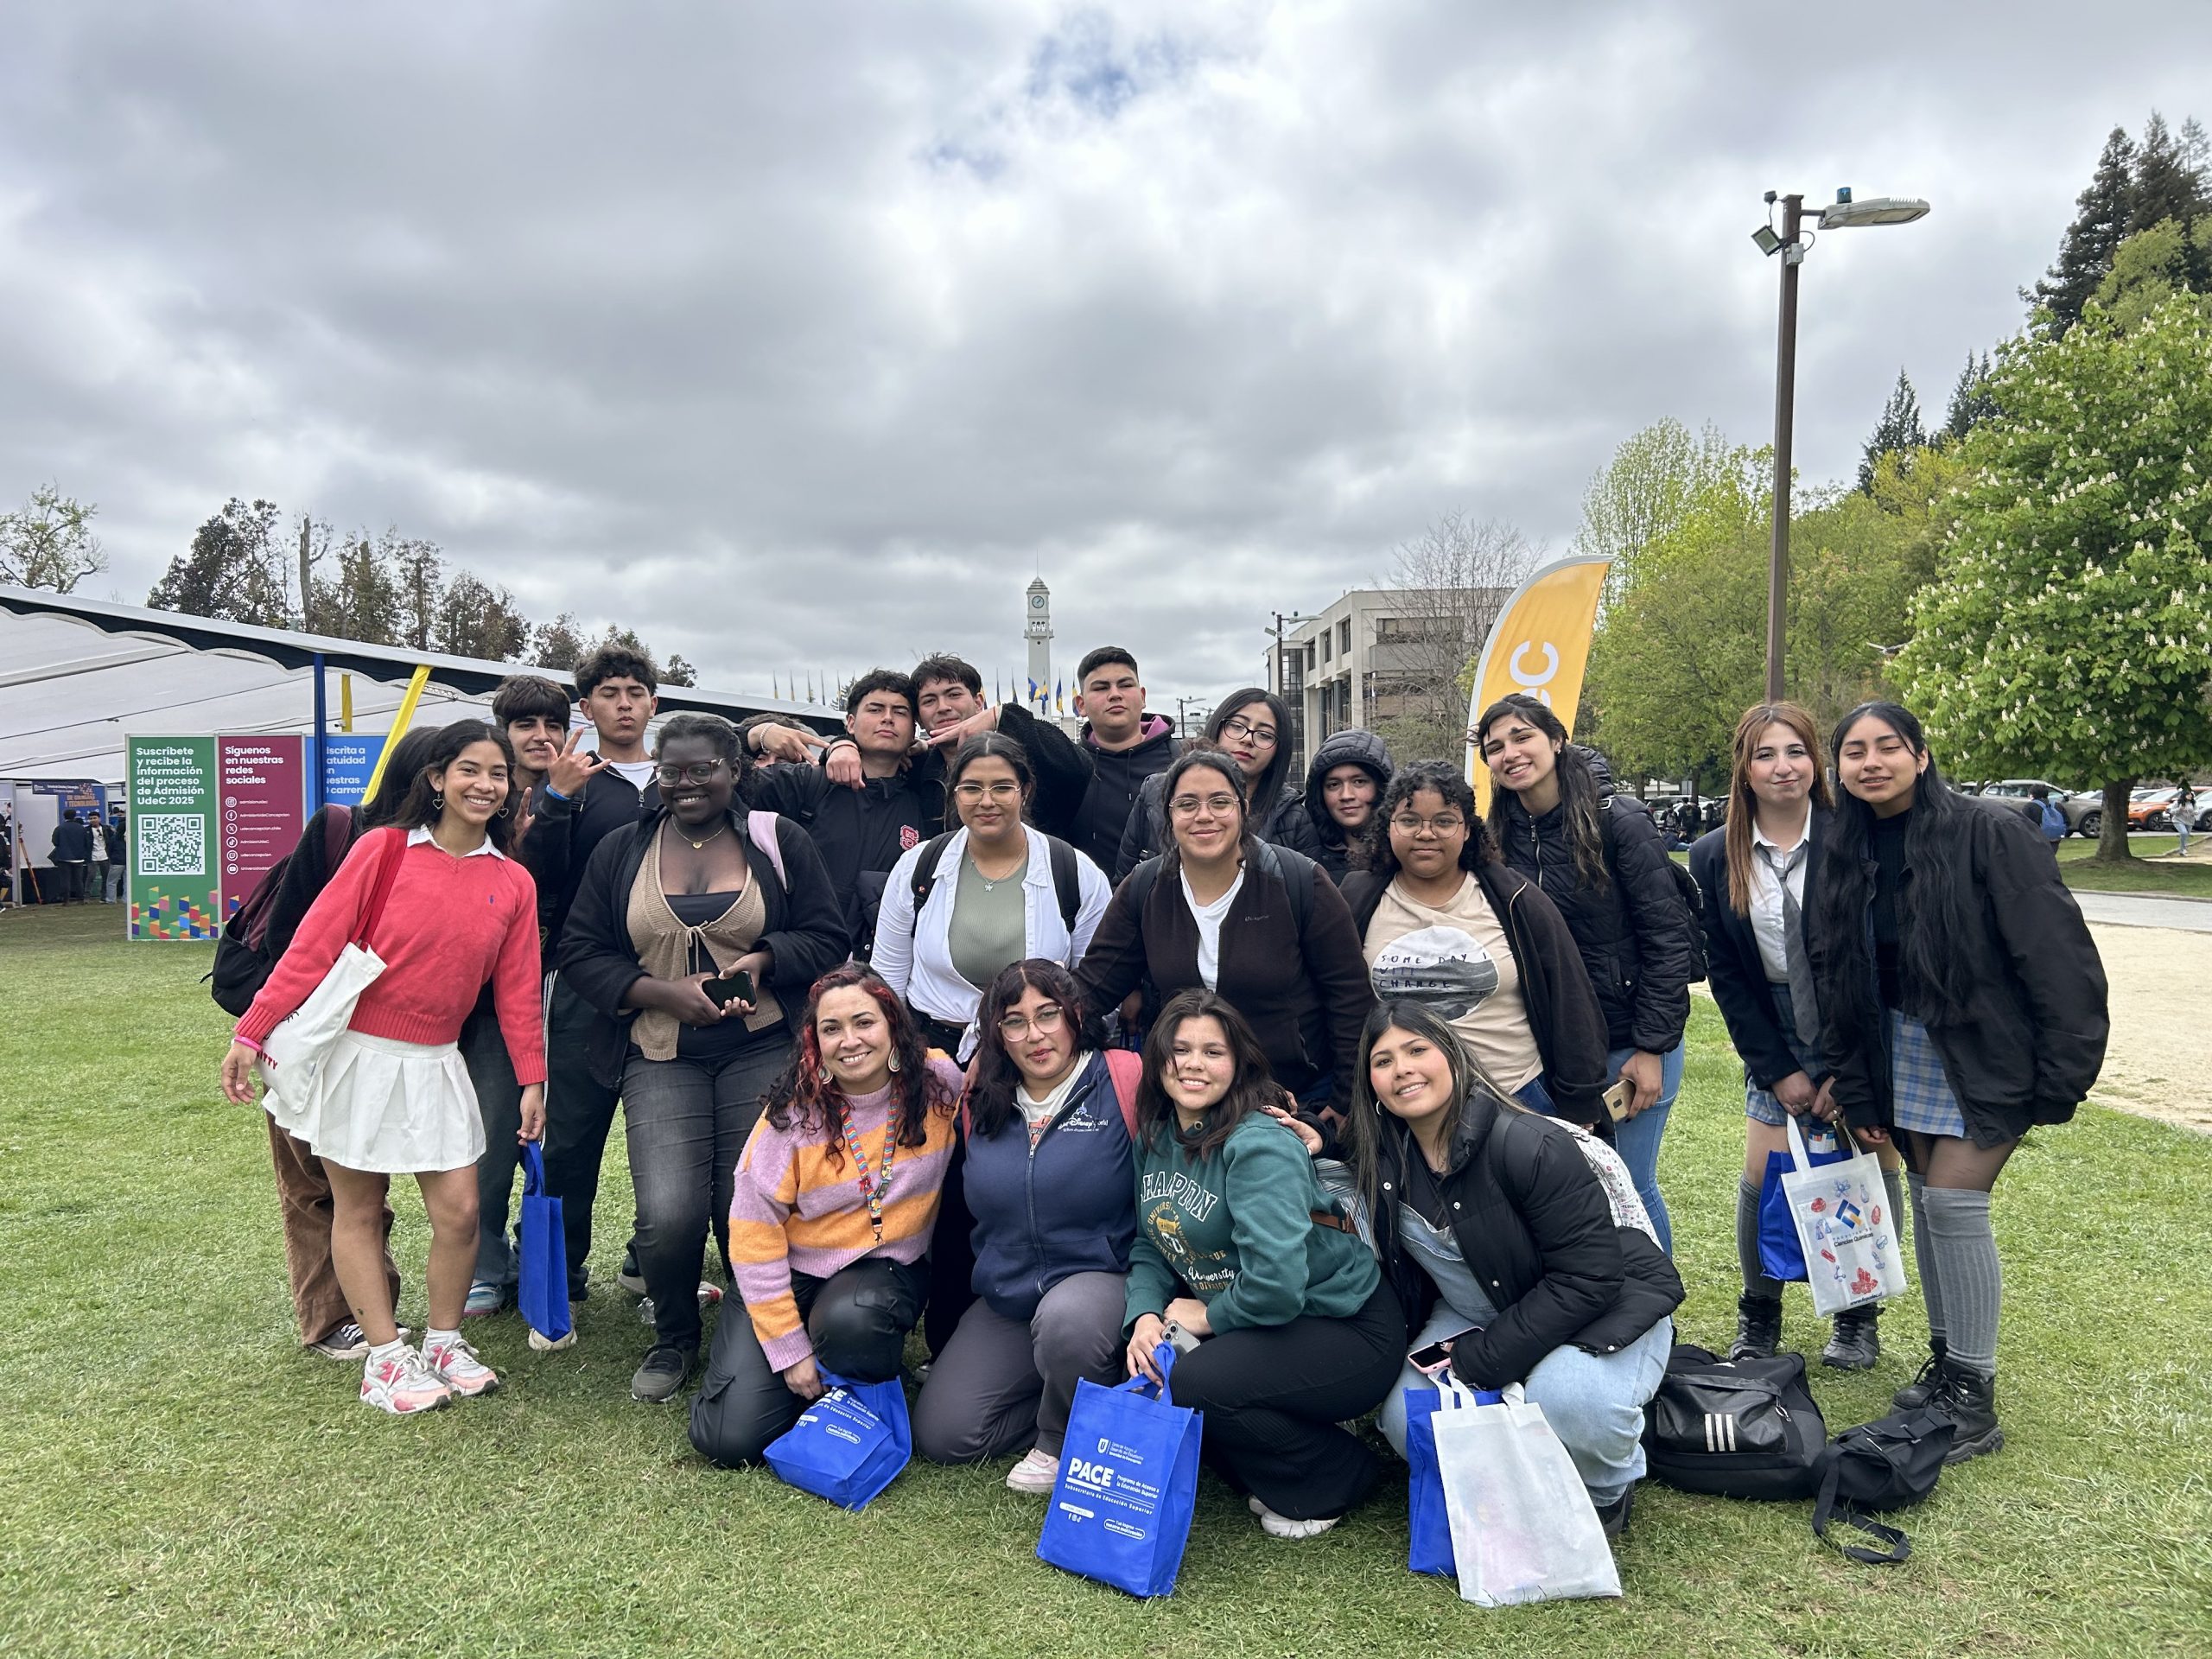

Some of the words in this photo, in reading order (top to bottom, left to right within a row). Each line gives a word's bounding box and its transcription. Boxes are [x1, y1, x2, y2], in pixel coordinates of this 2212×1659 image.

[137, 747, 194, 755] Suscríbete
[226, 746, 271, 757] Síguenos
[137, 759, 143, 768] y
[145, 757, 180, 766] recibe
[240, 756, 284, 765] nuestras
[327, 756, 365, 765] atuidad
[137, 766, 203, 775] información
[137, 777, 154, 785] del
[156, 778, 200, 787] proceso
[226, 776, 266, 785] sociales
[154, 785, 205, 795] Admisión
[137, 797, 167, 805] UdeC
[1382, 954, 1422, 964] SOME
[1439, 953, 1467, 964] DAY
[1379, 979, 1450, 988] CHANGE
[830, 1407, 852, 1419] Educación
[852, 1417, 872, 1430] Superior
[1068, 1458, 1115, 1487] PACE
[1117, 1475, 1135, 1485] Programa
[1121, 1483, 1141, 1493] Educación
[1141, 1490, 1158, 1499] Superior
[1103, 1495, 1128, 1507] Educación
[1129, 1503, 1153, 1515] Superior
